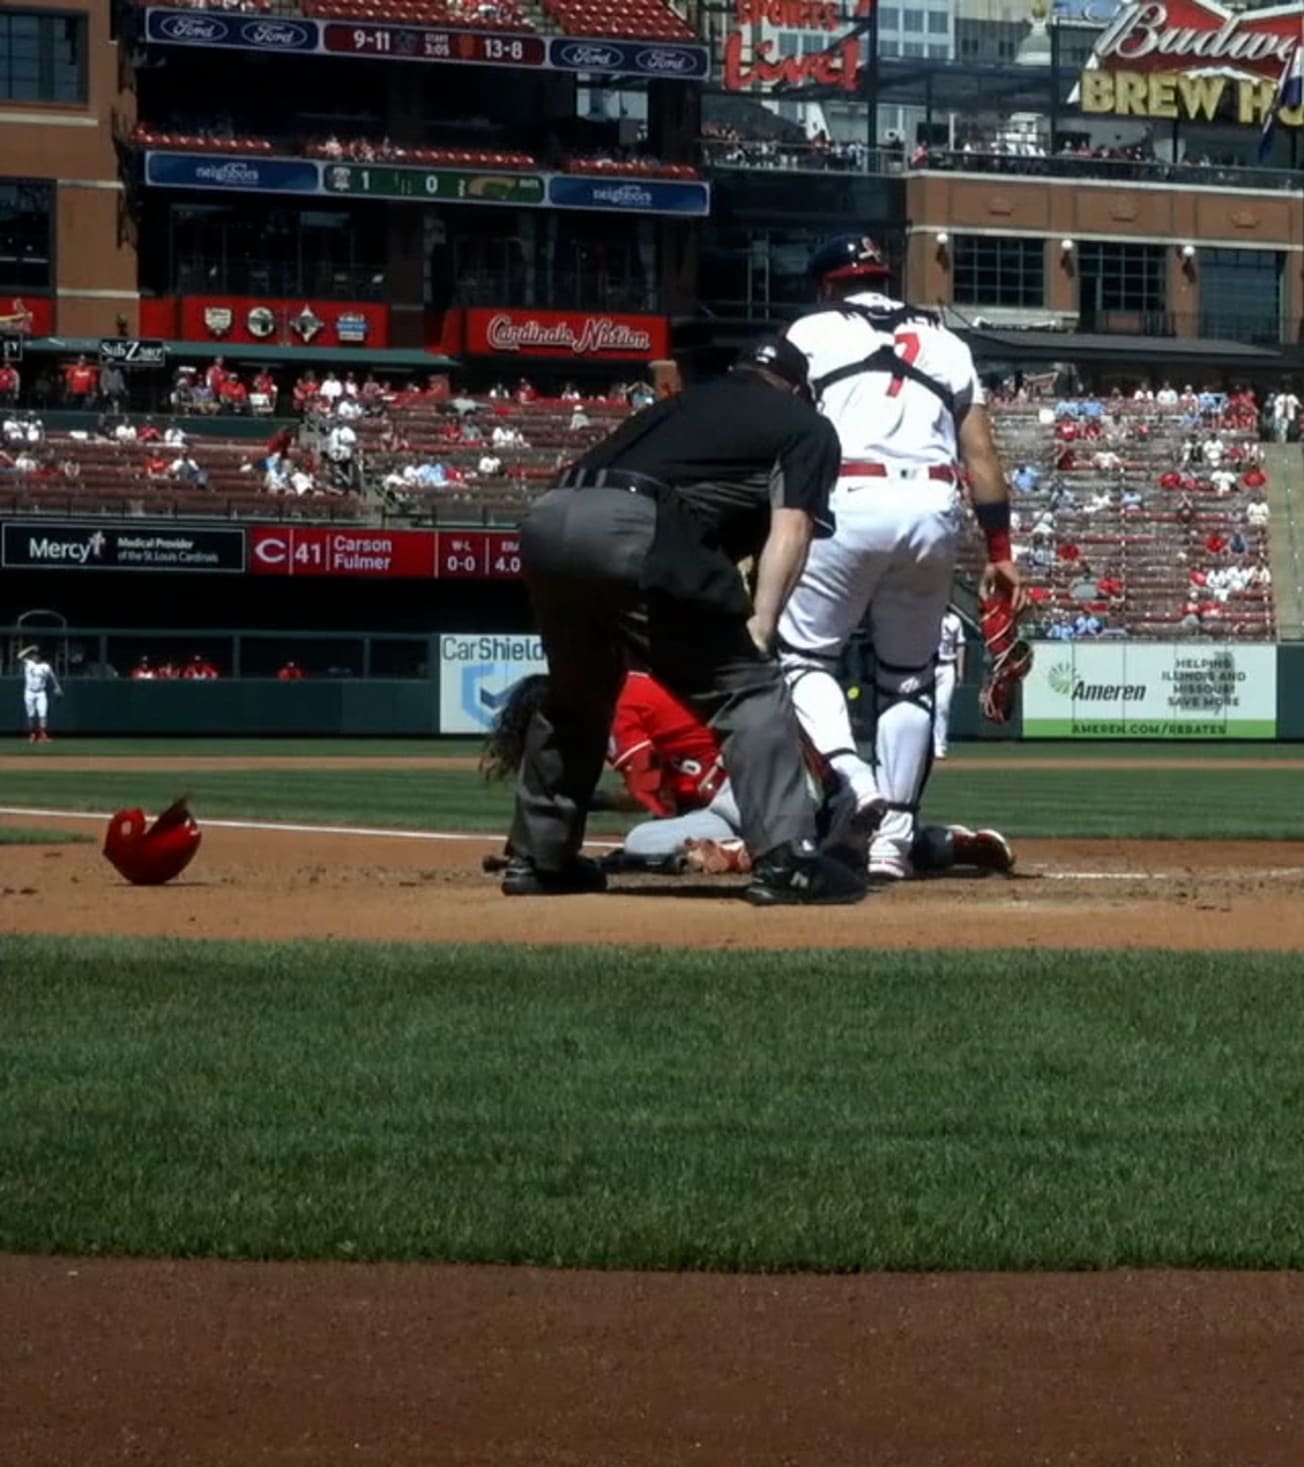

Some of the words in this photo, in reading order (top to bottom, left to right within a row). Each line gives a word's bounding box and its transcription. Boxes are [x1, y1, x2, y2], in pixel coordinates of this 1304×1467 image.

[172, 17, 214, 38] Ford
[253, 22, 295, 43] Ford
[354, 31, 390, 50] 9-11
[484, 39, 523, 59] 13-8
[572, 47, 611, 64] Ford
[647, 51, 686, 69] Ford
[1081, 69, 1227, 120] BREW
[426, 175, 438, 193] 0
[572, 317, 651, 353] Nation
[886, 332, 920, 397] 7
[29, 537, 91, 563] Mercy
[117, 537, 154, 548] Medical
[333, 535, 392, 553] Carson
[295, 543, 321, 564] 41
[333, 553, 391, 570] Fulmer
[447, 556, 475, 572] 0-0
[442, 636, 546, 661] CarShield
[1219, 671, 1246, 682] AND
[1071, 681, 1147, 701] Ameren
